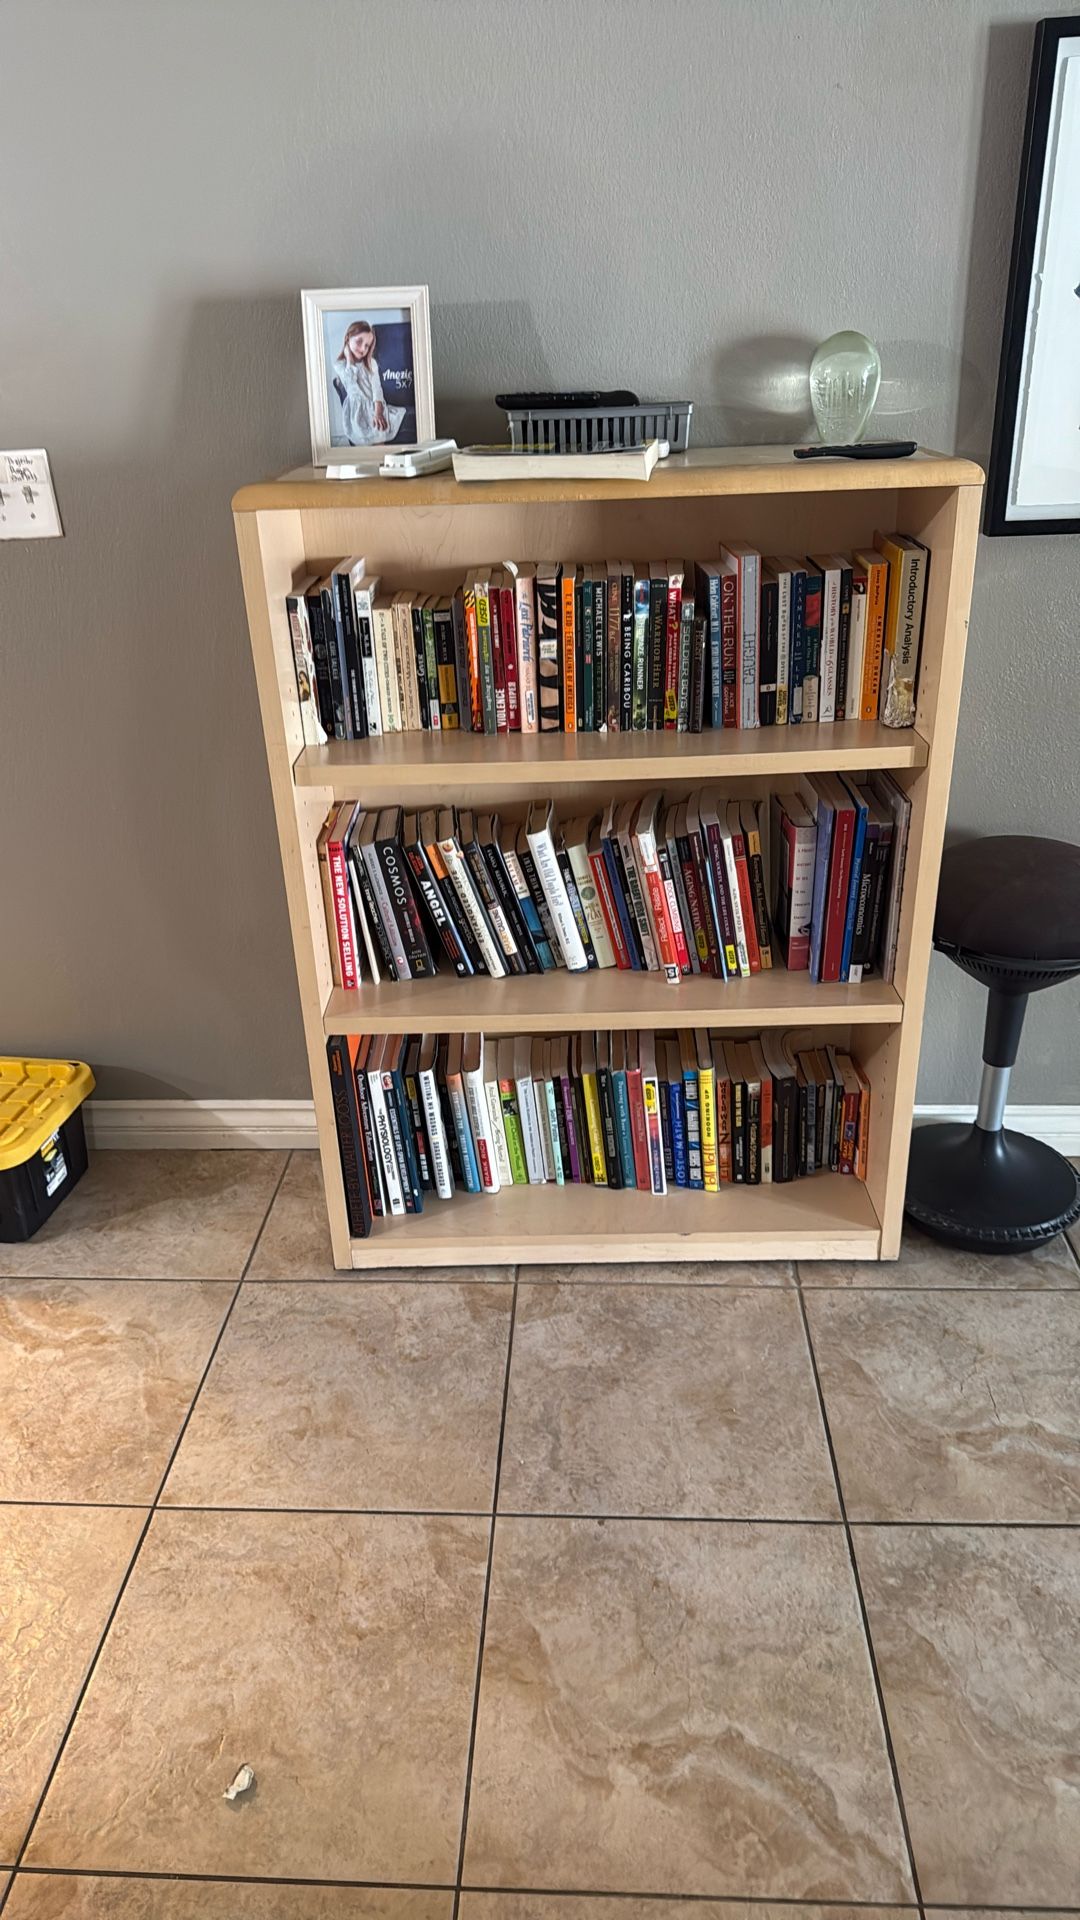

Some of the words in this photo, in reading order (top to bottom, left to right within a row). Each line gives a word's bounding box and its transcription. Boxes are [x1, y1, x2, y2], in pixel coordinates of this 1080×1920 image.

[710, 579, 719, 595] Helen
[724, 582, 734, 602] ON
[905, 558, 920, 620] Introductory
[479, 599, 488, 624] USED
[520, 602, 531, 620] Last
[610, 608, 620, 629] 1177
[724, 607, 734, 634] THE
[654, 615, 662, 663] WARRIOR
[682, 626, 690, 676] SOLDIER
[902, 624, 913, 664] Analysis
[724, 638, 734, 667] RUN
[743, 632, 755, 686] CAUGHT
[653, 664, 661, 688] HEIR
[508, 682, 517, 710] SNIPER
[680, 679, 688, 709] BOYS
[496, 688, 506, 727] VIOLENCE
[536, 842, 548, 858] What
[332, 856, 342, 874] THE
[383, 846, 407, 904] COSMOS
[523, 857, 534, 872] INTO
[541, 859, 551, 868] Are
[543, 870, 554, 878] Old
[626, 866, 636, 879] THE
[334, 875, 344, 896] NEW
[451, 870, 463, 889] LIFE
[527, 874, 538, 890] THIN
[546, 879, 559, 895] People
[629, 880, 641, 900] GREAT
[665, 882, 675, 899] ROCK
[684, 869, 697, 897] AGING
[420, 880, 446, 926] ANGEL
[533, 891, 543, 903] AIR
[856, 873, 871, 935] Microeconomics
[337, 898, 350, 940] SOLUTION
[460, 891, 484, 943] ENTANGLED
[669, 901, 681, 931] CLIMBING
[690, 898, 702, 930] NATION
[637, 919, 649, 936] SHIFT
[658, 918, 669, 942] Reflect
[342, 942, 353, 976] SELLING
[357, 1074, 368, 1099] Outdoor
[423, 1075, 432, 1100] WRITING
[704, 1089, 710, 1099] UP
[361, 1101, 371, 1130] Adventure
[427, 1102, 434, 1110] MY
[428, 1112, 438, 1136] WRONGS
[675, 1120, 684, 1149] MATH
[365, 1131, 374, 1161] Education
[377, 1115, 392, 1164] PHYSIOLOGY
[720, 1133, 730, 1144] Z
[664, 1148, 672, 1166] FIELD
[399, 1163, 410, 1193] DEVELOPMENT
[483, 1161, 491, 1185] FRANK
[677, 1160, 685, 1184] LOST
